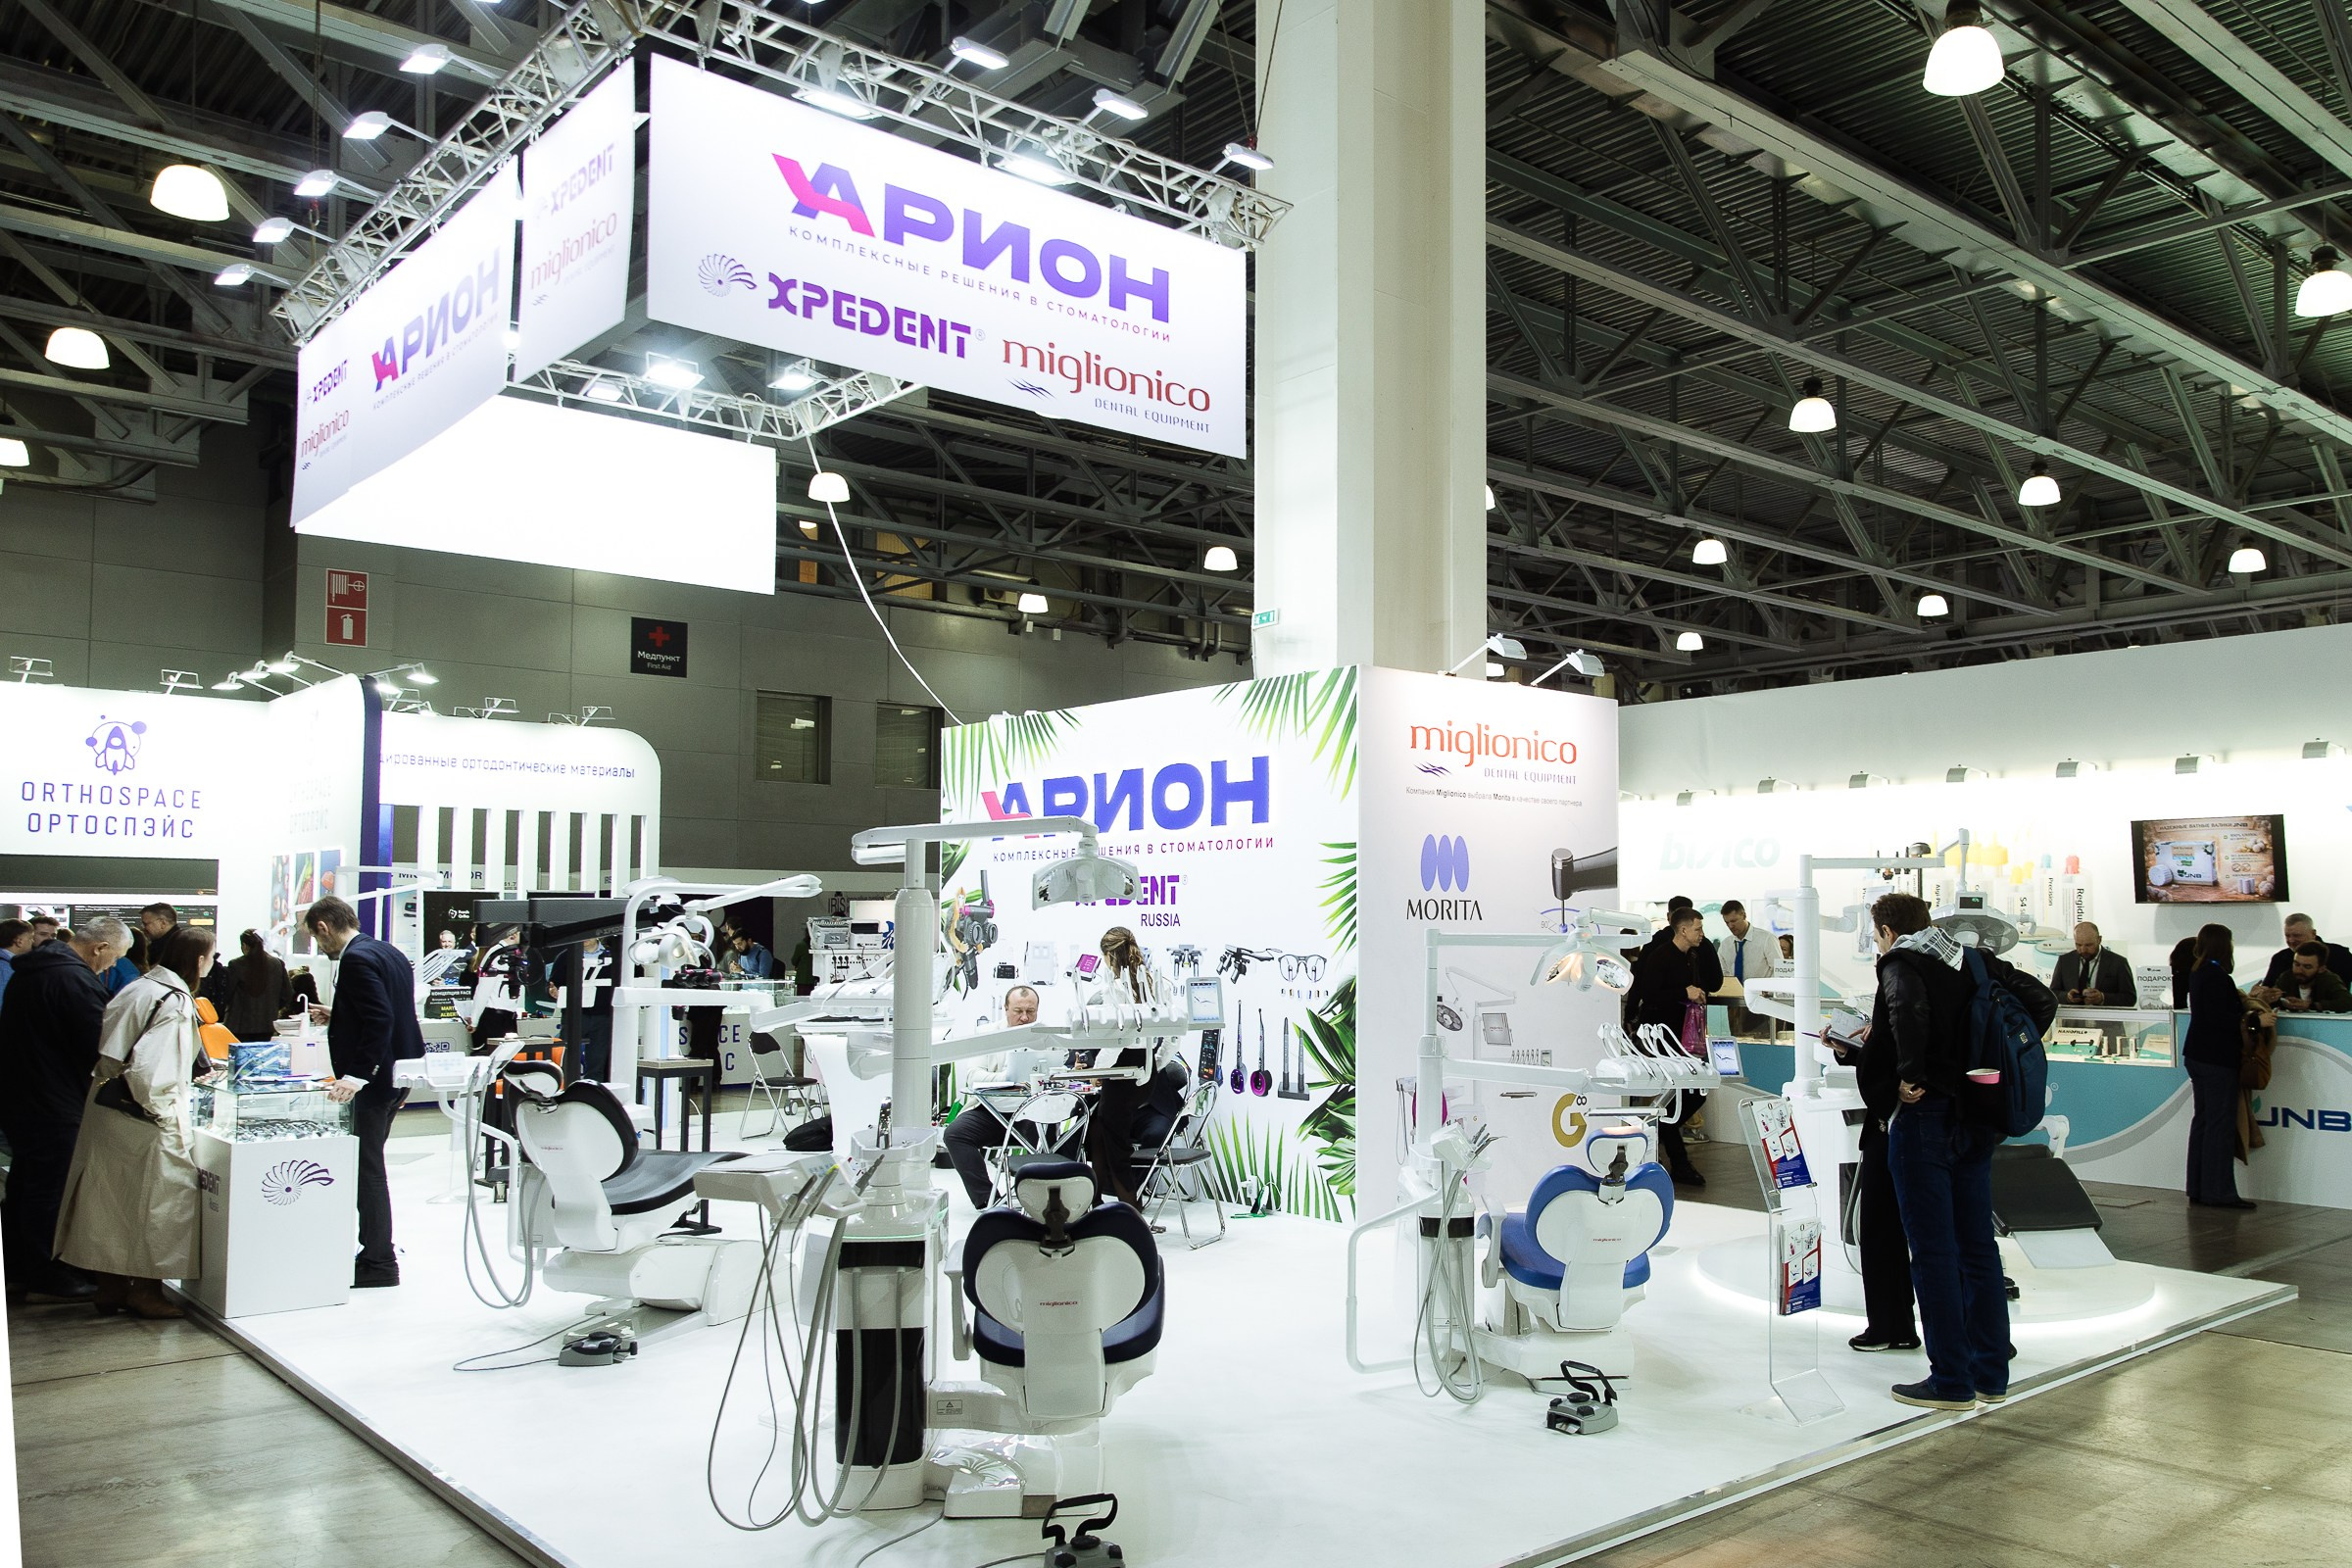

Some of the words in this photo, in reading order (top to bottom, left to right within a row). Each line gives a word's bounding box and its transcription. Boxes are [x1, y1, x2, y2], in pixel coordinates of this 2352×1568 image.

[531, 212, 617, 290] miglionico
[772, 153, 1170, 323] АРИОН
[789, 225, 933, 275] КОМПЛЕКСНЫЕ
[941, 270, 1022, 302] РЕШЕНИЯ
[1030, 296, 1039, 308] В
[1047, 301, 1172, 344] СТОМАТОЛОГИИ
[371, 246, 500, 393] АРИОН
[768, 271, 971, 360] XPEDENT
[313, 359, 348, 404] XPEDENT
[1003, 336, 1211, 413] miglionico
[1095, 398, 1139, 418] DENTAL
[1145, 410, 1211, 434] EQUIPMENT
[300, 409, 350, 459] miglionico
[637, 651, 681, 662] Медпункт
[1409, 720, 1577, 766] miglionico
[380, 753, 458, 768] ированные
[462, 758, 566, 774] ортодонтические
[570, 763, 635, 779] материалы
[1484, 767, 1519, 780] DENTAL
[1524, 770, 1577, 784] EQUIPMENT
[21, 780, 203, 810] ORTHOSPACE
[1405, 786, 1436, 796] Компания
[1436, 788, 1467, 799] Miglionico
[1493, 793, 1511, 802] Morita
[27, 810, 195, 839] ОРТОСПЭЙС
[993, 848, 1076, 862] КОМПЛЕКСНЫЕ
[1098, 844, 1140, 857] ШЕНИЯ
[1147, 843, 1153, 855] В
[1160, 837, 1275, 852] СТОМАТОЛОГИИ
[828, 898, 846, 913] IRIS
[1406, 899, 1483, 921] MORITA
[2020, 897, 2028, 907] S4
[1140, 912, 1181, 927] RUSSIA
[2256, 1106, 2352, 1132] JNB
